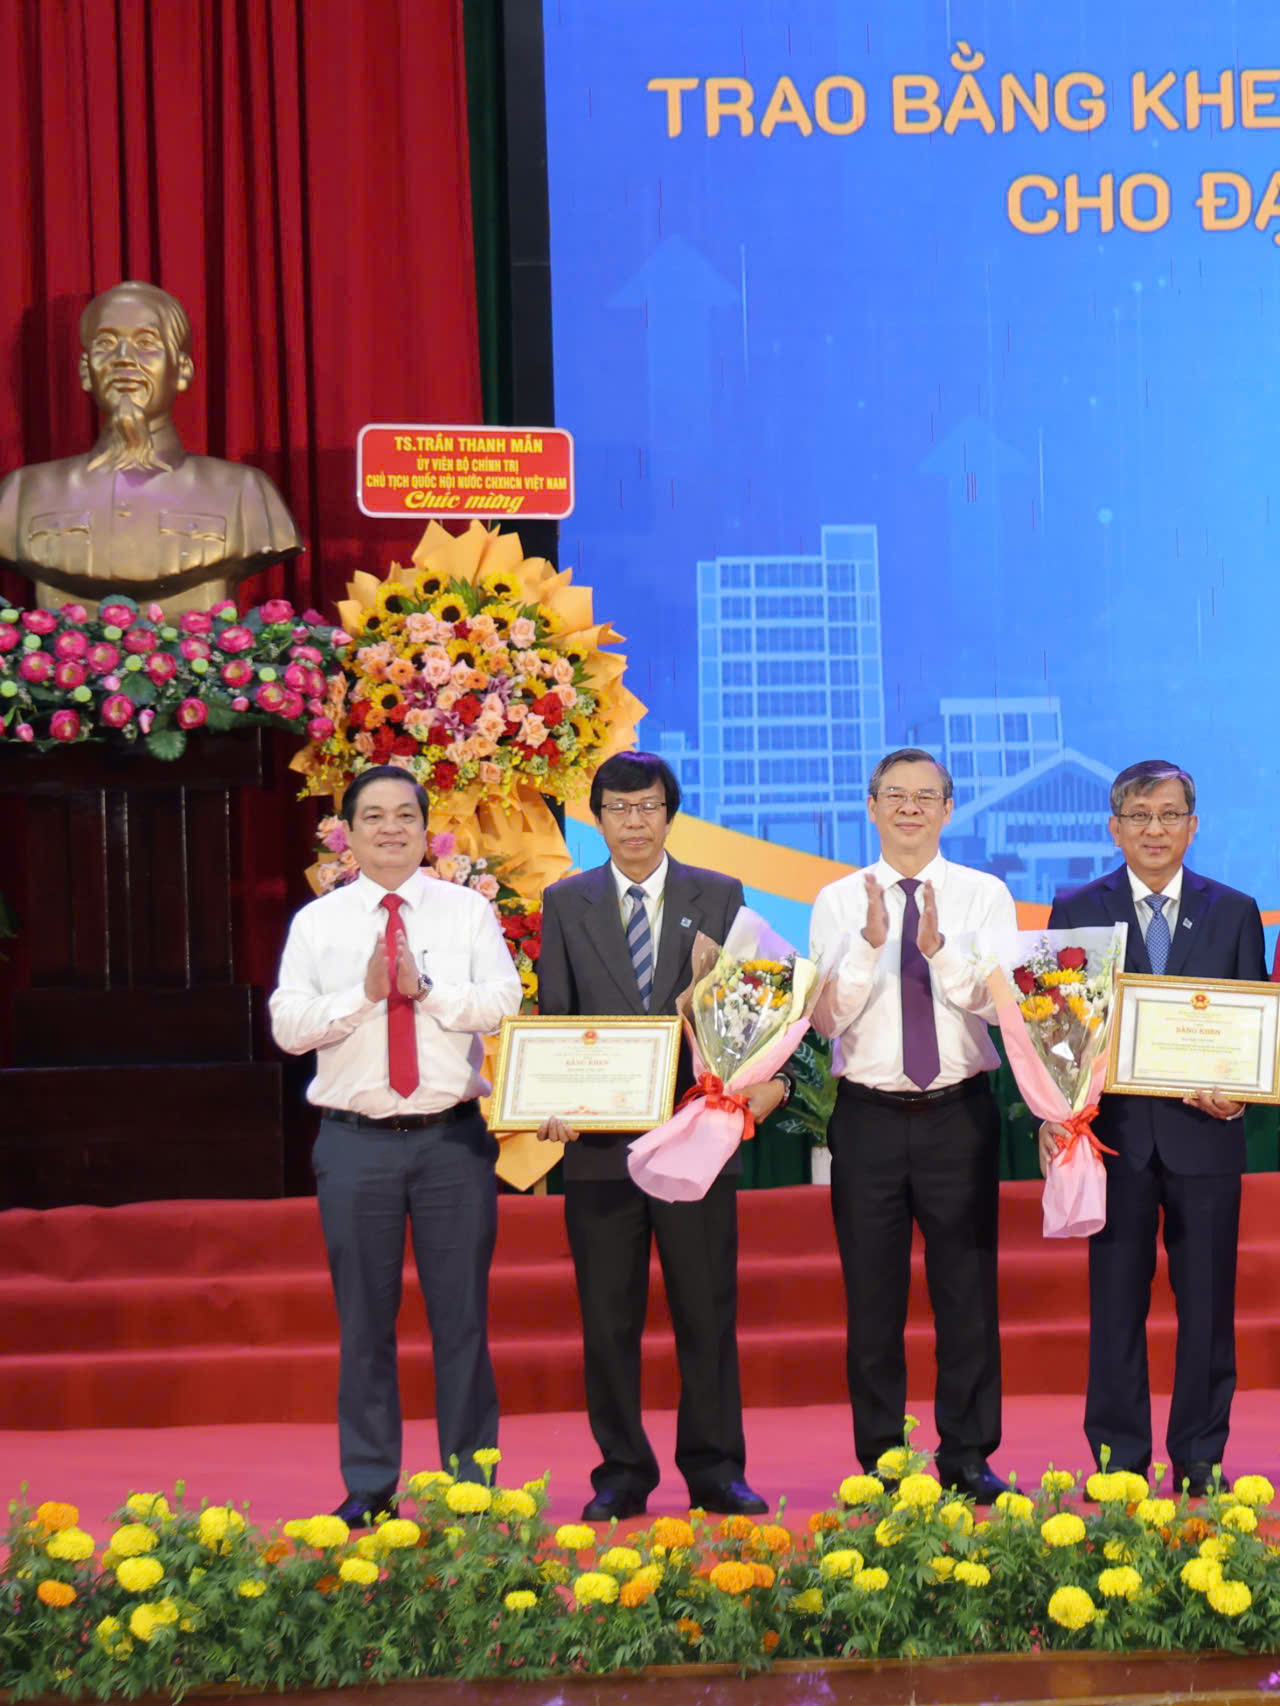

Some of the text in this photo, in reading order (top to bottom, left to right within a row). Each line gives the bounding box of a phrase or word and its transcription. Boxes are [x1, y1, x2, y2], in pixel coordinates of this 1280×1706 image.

[648, 75, 866, 137] TRAO
[893, 41, 1106, 134] BẰNG
[1007, 173, 1170, 234] CHO
[458, 437, 506, 453] THANH
[432, 456, 454, 472] VIÊN
[456, 457, 469, 474] BỘ
[471, 457, 501, 473] CHÍNH
[503, 459, 519, 475] TRỊ
[366, 472, 386, 488] CHỦ
[388, 474, 409, 490] TỊCH
[412, 473, 437, 489] QUỐC
[439, 474, 456, 491] HỘI
[524, 474, 544, 492] VIỆT
[546, 477, 567, 490] NAM
[405, 491, 525, 513] Chúc mừng
